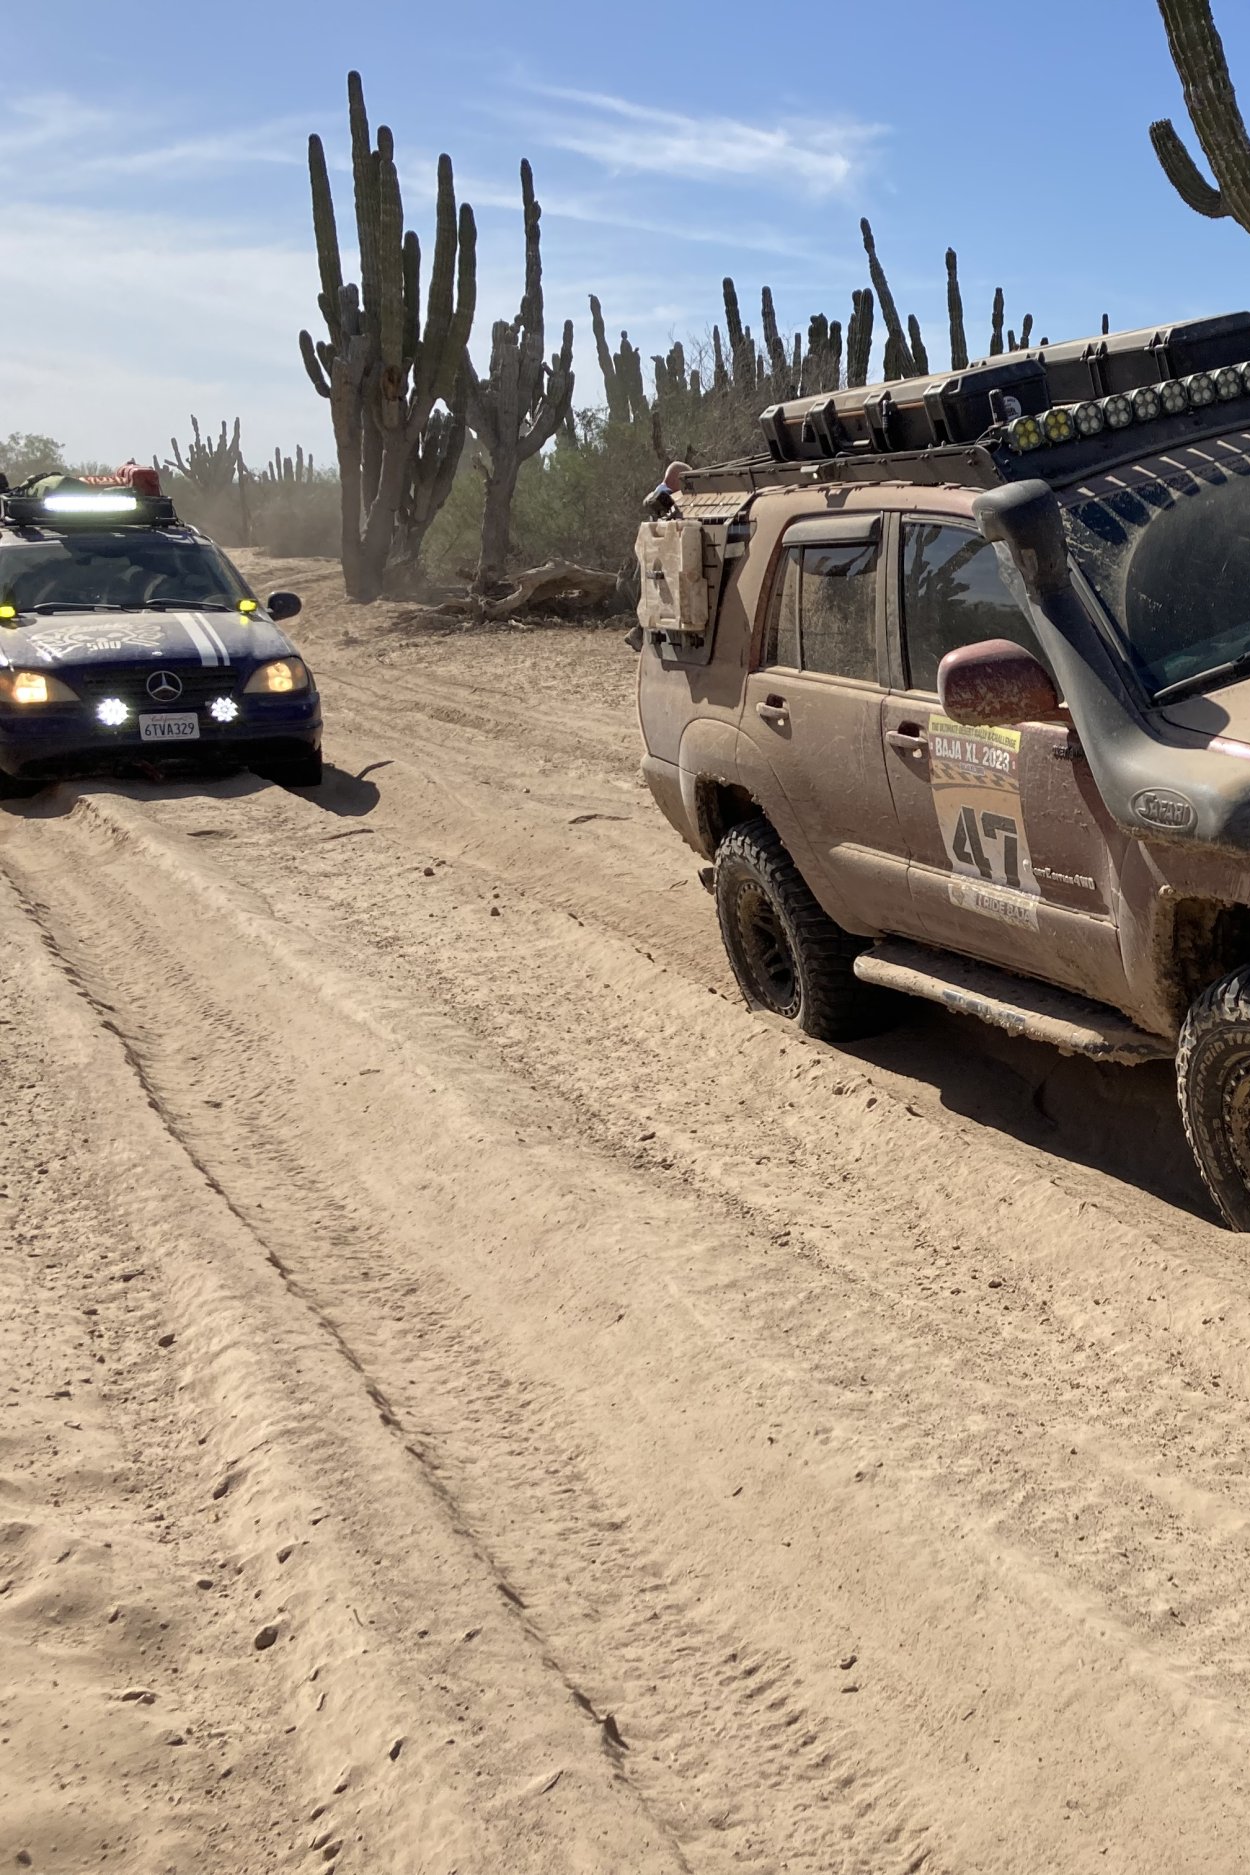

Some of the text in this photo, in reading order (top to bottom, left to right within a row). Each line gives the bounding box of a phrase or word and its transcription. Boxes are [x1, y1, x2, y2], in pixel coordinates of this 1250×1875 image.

[86, 640, 121, 651] 500
[144, 722, 195, 736] 6TVA329
[935, 737, 1010, 773] BAJA XL 2023
[1137, 792, 1191, 825] SAFARI
[952, 805, 1021, 889] 47
[983, 897, 1005, 914] RIDE
